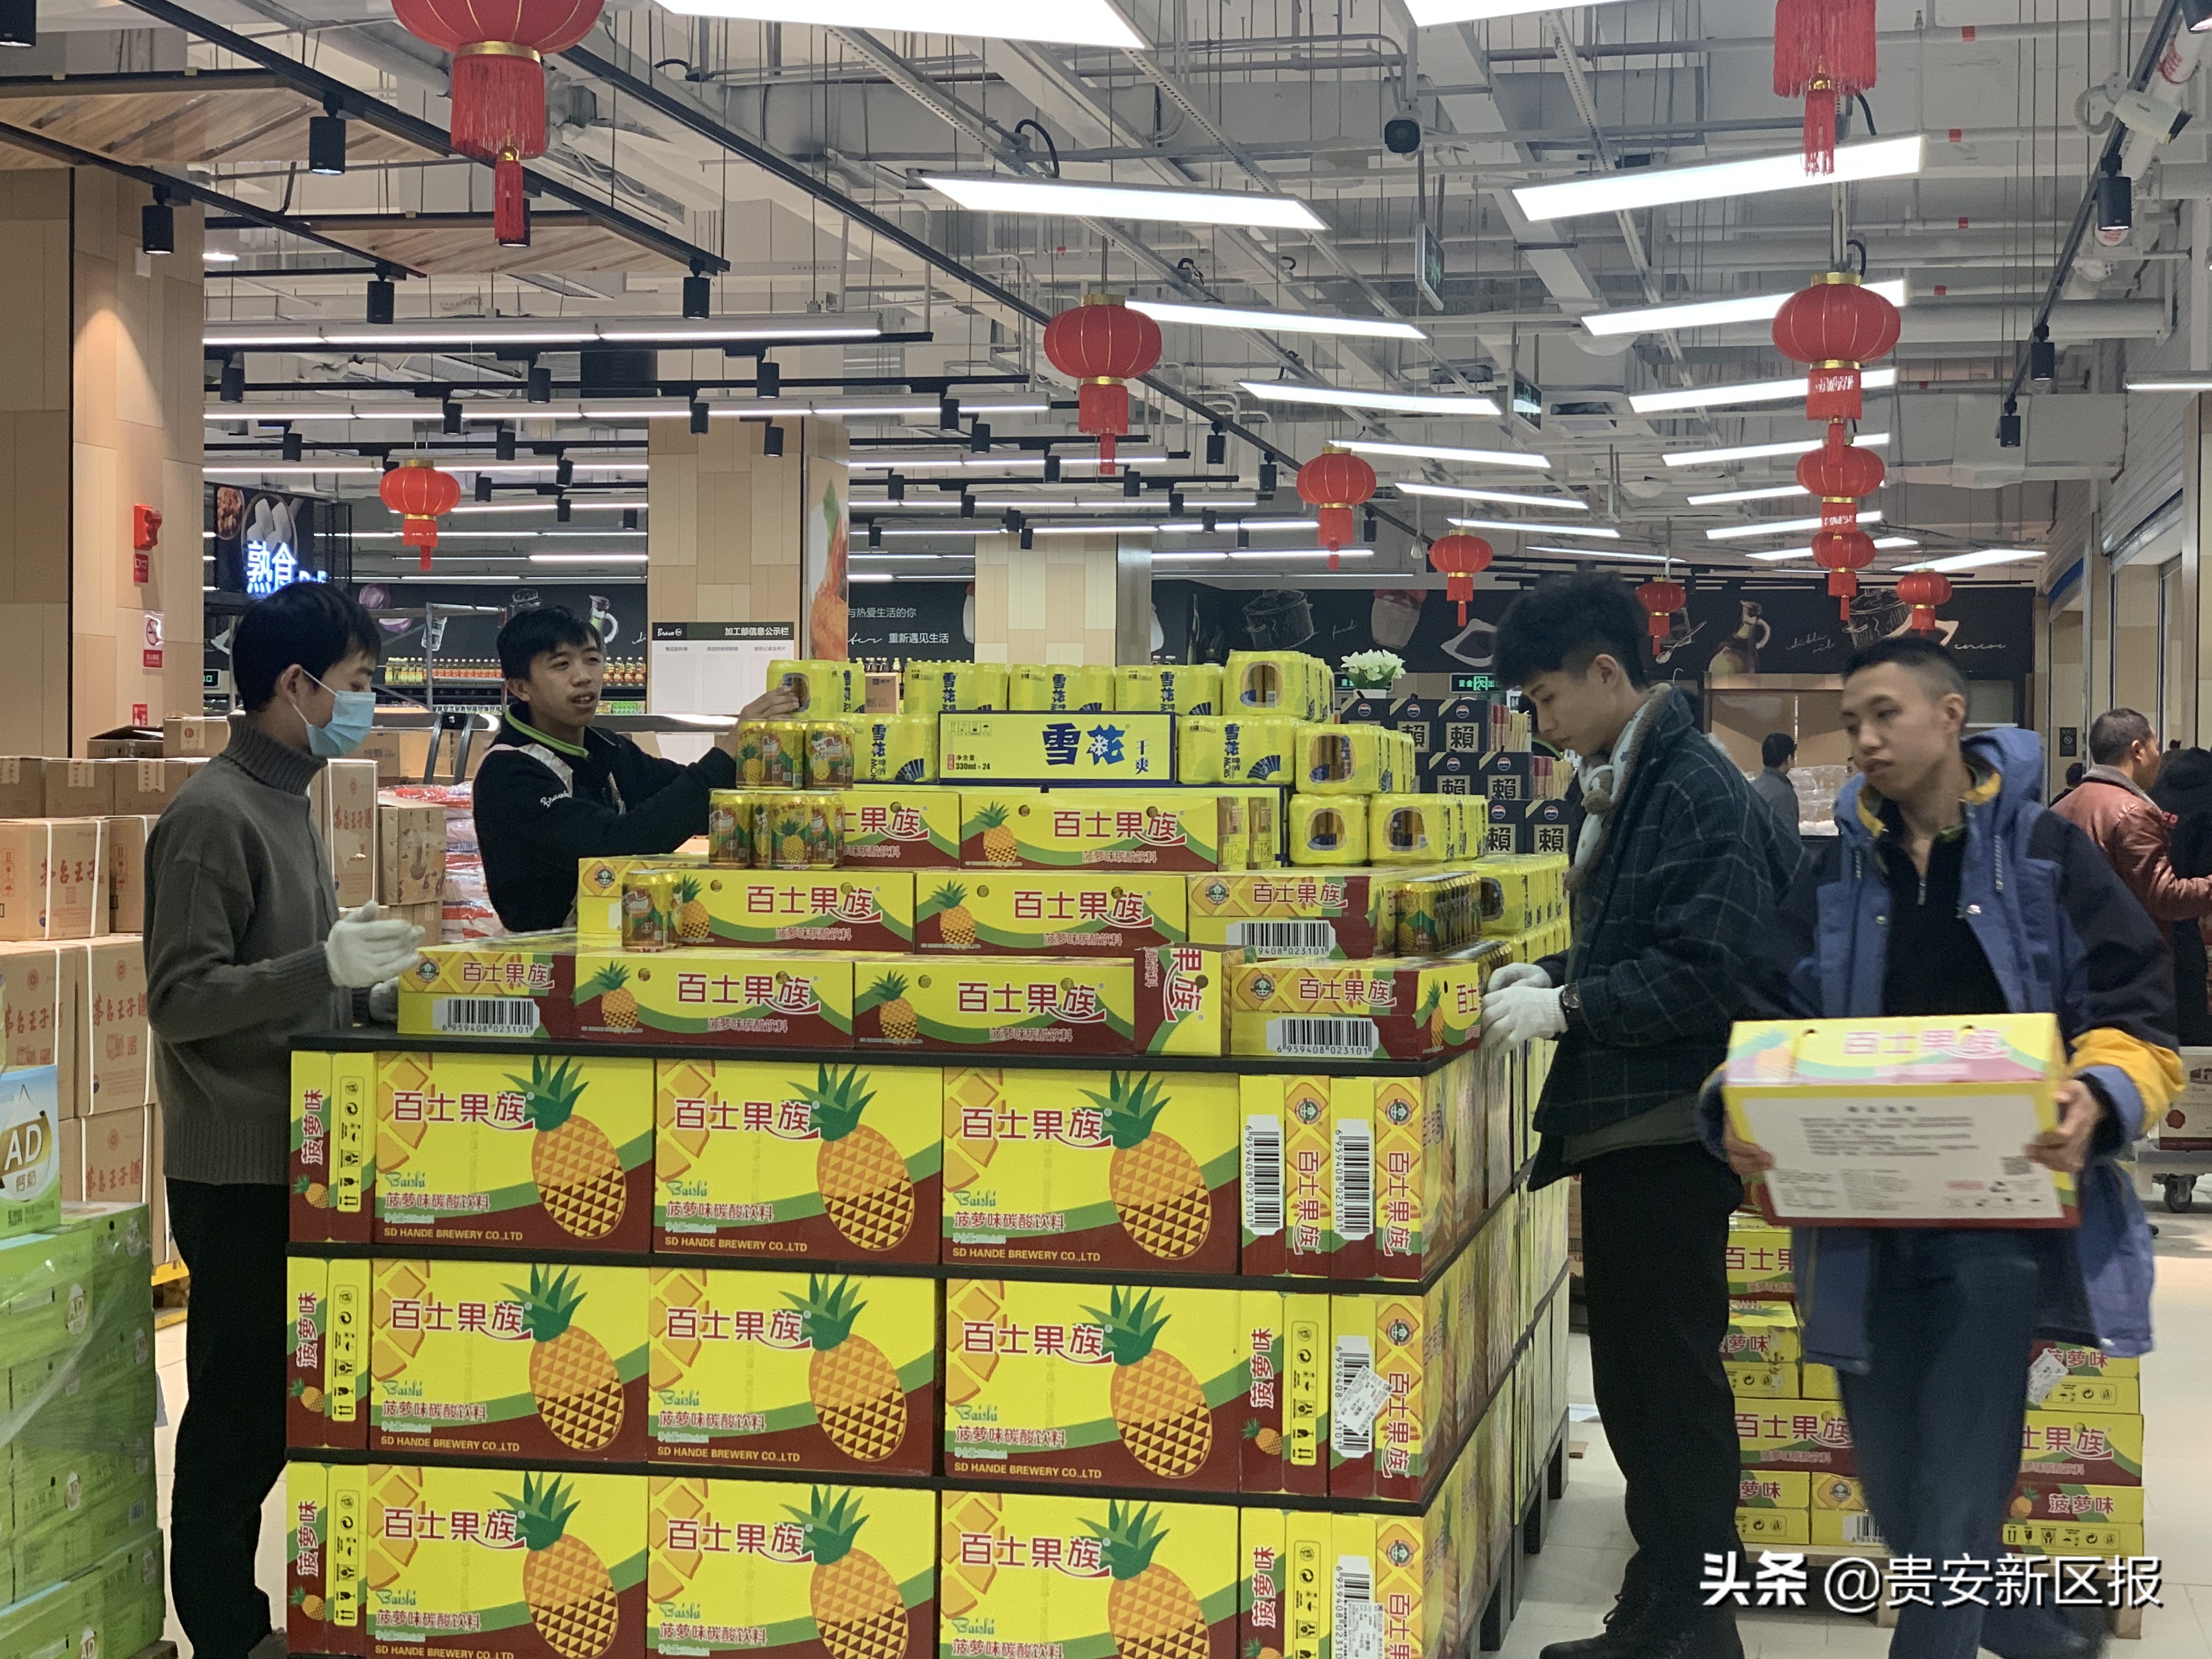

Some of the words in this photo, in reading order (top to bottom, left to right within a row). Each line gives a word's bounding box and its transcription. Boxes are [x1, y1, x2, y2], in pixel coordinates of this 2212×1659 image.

[247, 540, 296, 593] 熟食
[848, 607, 917, 618] 与热爱生活的你
[725, 627, 789, 636] 加工部信息公示栏
[888, 633, 949, 644] 重新遇见生活
[943, 672, 956, 703] 雪花
[1052, 674, 1066, 703] 雪花
[1160, 671, 1175, 702] 雪花
[871, 724, 887, 757] 雪花
[1042, 723, 1126, 766] 雪花
[1224, 723, 1240, 755] 雪花
[1450, 726, 1474, 747] 賴
[1135, 739, 1150, 775] 干爽
[1053, 810, 1187, 847] 百士果族
[1539, 828, 1564, 851] 賴
[747, 885, 883, 924] 百士果族
[1014, 890, 1154, 928] 百士果族
[1253, 883, 1348, 909] 百士果族
[463, 962, 555, 990] 百士果族
[678, 973, 821, 1015] 百士果族
[958, 981, 1107, 1024] 百士果族
[1299, 978, 1397, 1007] 百士果族
[1457, 982, 1481, 1014] 百士
[301, 1088, 324, 1165] 菠萝味
[393, 1091, 535, 1131] 百士果族
[674, 1098, 822, 1141] 百士果族
[961, 1107, 1113, 1148] 百士果族
[4, 1124, 42, 1171] AD
[386, 1192, 491, 1212] 菠萝味碳酸饮料
[665, 1200, 774, 1221] 菠萝味碳酸饮料
[1293, 1150, 1321, 1255] 百士果族
[1384, 1150, 1412, 1257] 百士果族
[384, 1228, 398, 1237] SD
[400, 1228, 433, 1238] HANDE
[436, 1229, 483, 1239] BREWERY
[954, 1211, 1065, 1231] 菠萝味碳酸饮料
[665, 1236, 679, 1245] SD
[681, 1237, 715, 1248] HANDE
[718, 1238, 766, 1250] BREWERY
[953, 1248, 967, 1257] SD
[969, 1249, 1005, 1259] HANDE
[1008, 1250, 1058, 1260] BREWERY
[296, 1291, 319, 1369] 菠萝味
[390, 1299, 533, 1341] 百士果族
[666, 1307, 812, 1350] 百士果族
[963, 1321, 1114, 1364] 百士果族
[1719, 1334, 1769, 1353] 萝味
[1250, 1326, 1274, 1410] 菠萝味
[382, 1400, 488, 1421] 菠萝味碳酸饮料
[658, 1410, 766, 1431] 菠萝味碳酸饮料
[1383, 1372, 1412, 1479] 百士果族
[381, 1436, 394, 1446] SD
[397, 1437, 431, 1447] HANDE
[433, 1438, 481, 1449] BREWERY
[955, 1425, 1067, 1447] 菠萝味碳酸饮料
[657, 1446, 672, 1455] SD
[673, 1447, 708, 1458] HANDE
[711, 1449, 759, 1460] BREWERY
[954, 1462, 969, 1472] SD
[971, 1463, 1007, 1474] HANDE
[1009, 1465, 1059, 1476] BREWERY
[2048, 1493, 2114, 1514] 菠萝味
[297, 1499, 319, 1578] 菠萝味
[383, 1508, 526, 1550] 百士果族
[668, 1519, 814, 1563] 百士果族
[960, 1533, 1112, 1578] 百士果族
[1251, 1545, 1277, 1629] 菠萝味
[376, 1609, 482, 1630] 菠萝味碳酸饮料
[1335, 1565, 1344, 1659] 695940802310
[659, 1622, 767, 1645] 菠萝味碳酸饮料
[952, 1638, 1064, 1659] 菠萝味碳酸饮料
[375, 1645, 389, 1655] SD
[391, 1646, 425, 1656] HANDE
[427, 1648, 475, 1659] BREWERY
